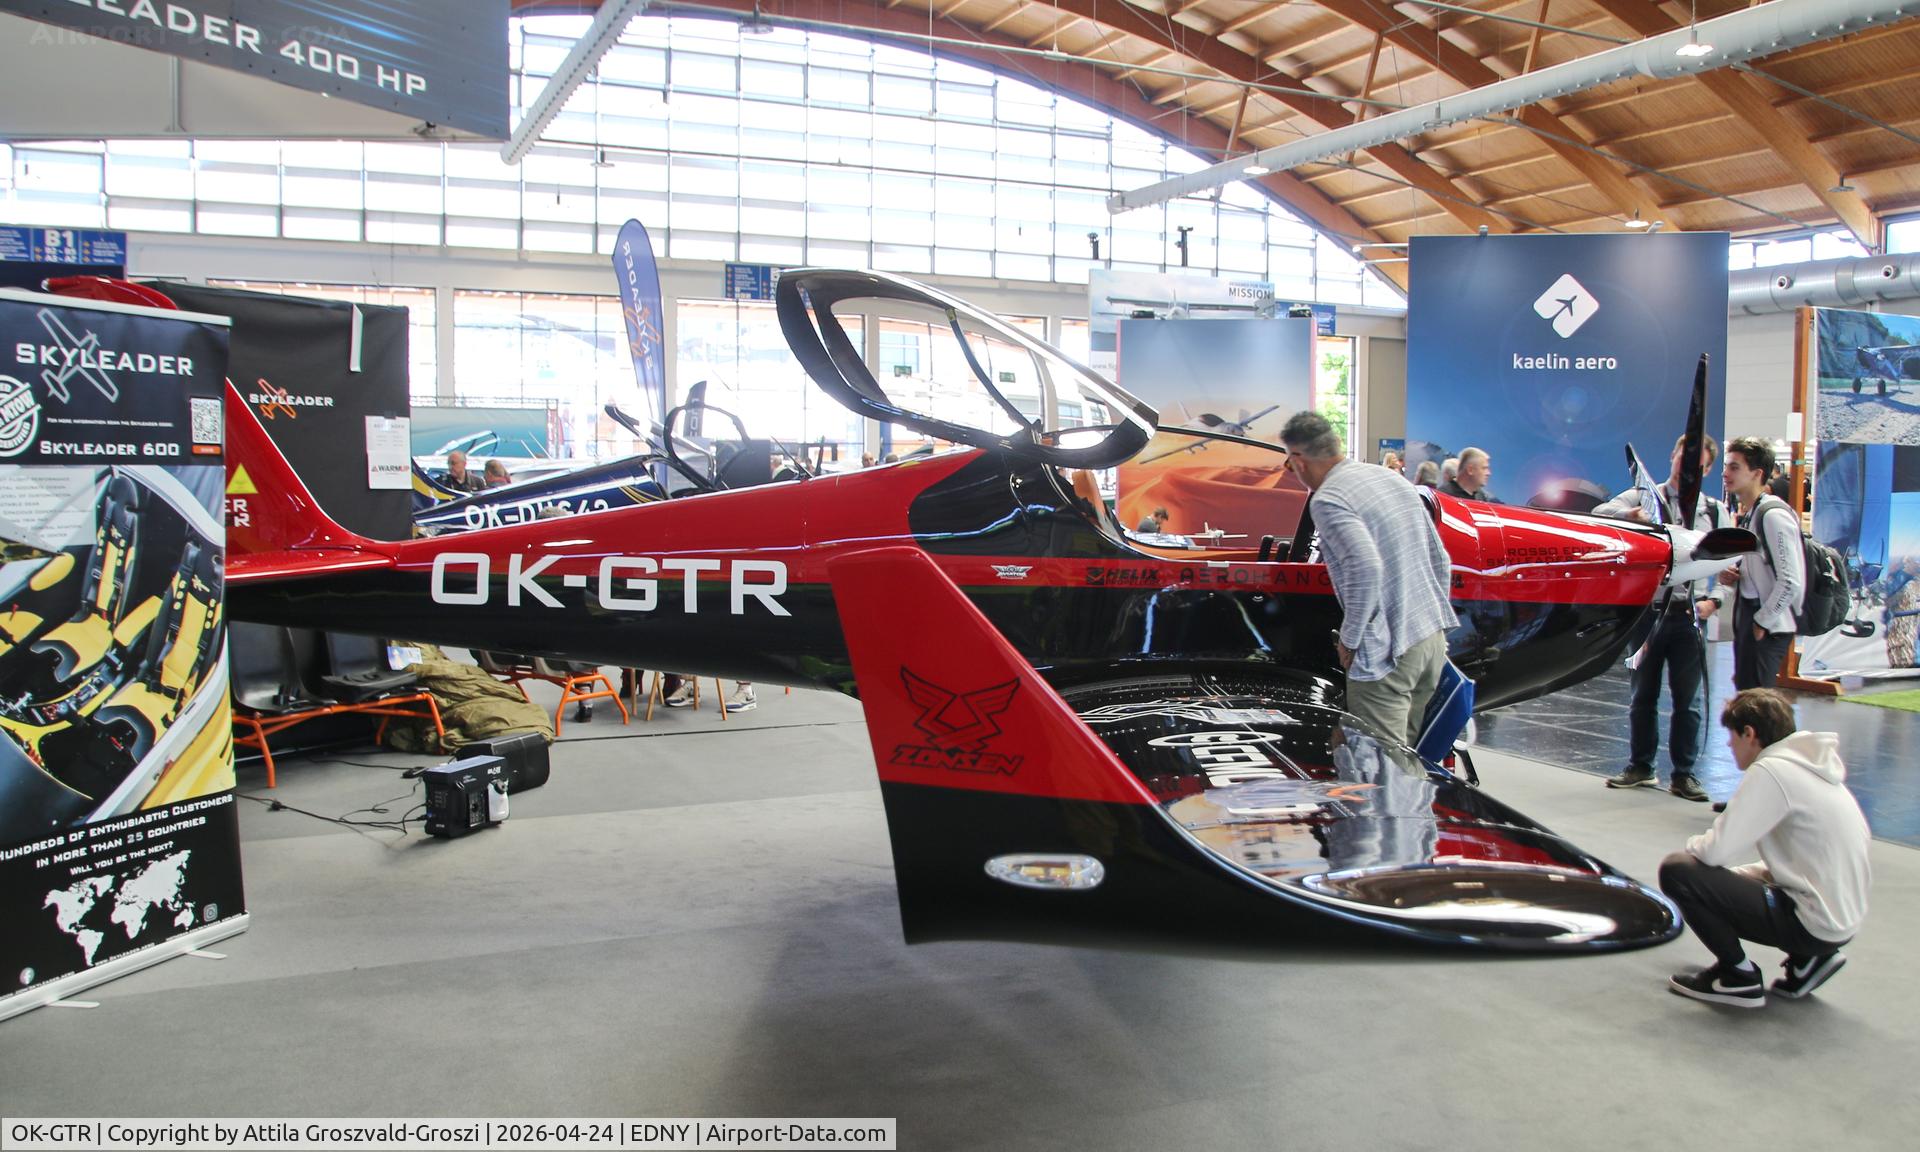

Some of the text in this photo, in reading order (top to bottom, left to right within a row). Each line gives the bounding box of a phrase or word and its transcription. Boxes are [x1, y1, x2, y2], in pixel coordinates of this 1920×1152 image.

[65, 0, 427, 97] EADER 400 HP
[44, 229, 74, 248] B1
[1229, 287, 1271, 300] MISSION
[16, 343, 193, 376] SKYLEADER
[1513, 353, 1617, 370] kaelin aero
[250, 394, 334, 407] SKYLEADER
[143, 443, 180, 456] 600
[1507, 547, 1559, 556] ROSSO
[1106, 568, 1160, 580] HELIX
[431, 552, 792, 617] OK-GTR
[69, 831, 86, 842] OF
[89, 811, 169, 838] ENTHUSIASTIC
[172, 794, 233, 815] CUSTOMERS
[36, 816, 207, 869] IN MORE THAN 25 COUNTRIES
[70, 840, 174, 875] WILL YOU BE THE NEXT?
